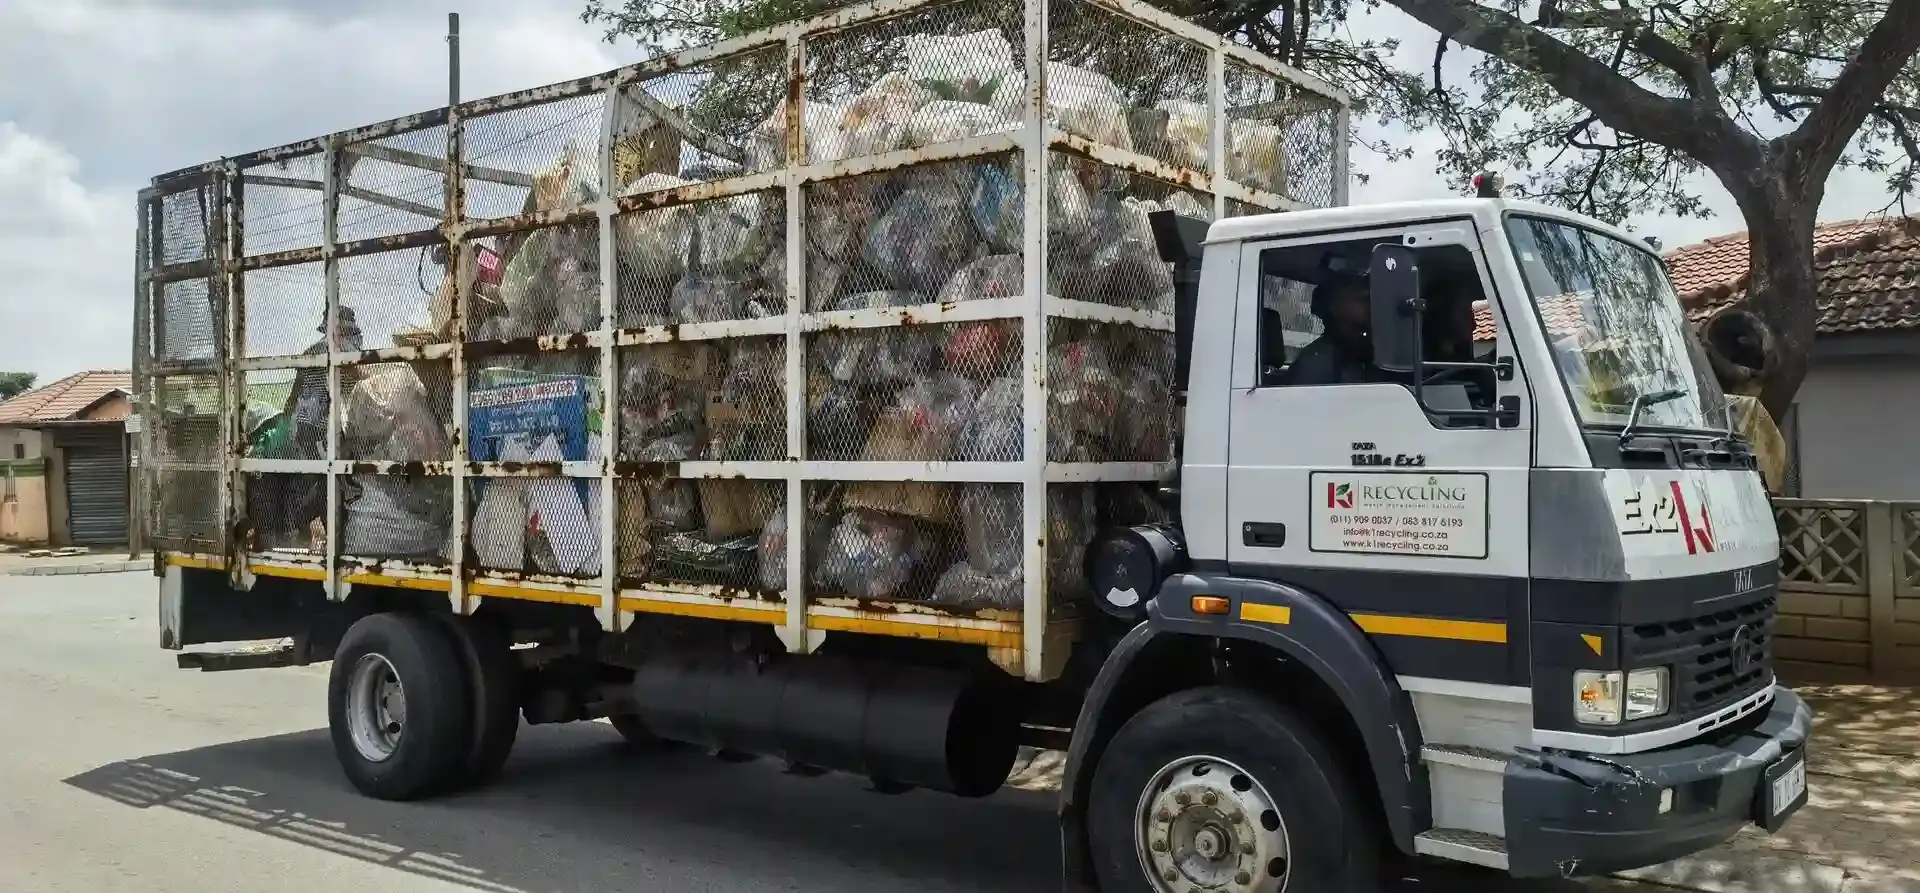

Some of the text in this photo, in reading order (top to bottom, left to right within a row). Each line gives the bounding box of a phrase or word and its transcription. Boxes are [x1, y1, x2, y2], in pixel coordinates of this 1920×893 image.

[1352, 442, 1376, 451] TATA
[1363, 485, 1466, 502] RECYCLING
[1330, 515, 1352, 526] (011)
[1353, 515, 1370, 526] 909
[1440, 518, 1464, 528] 6193
